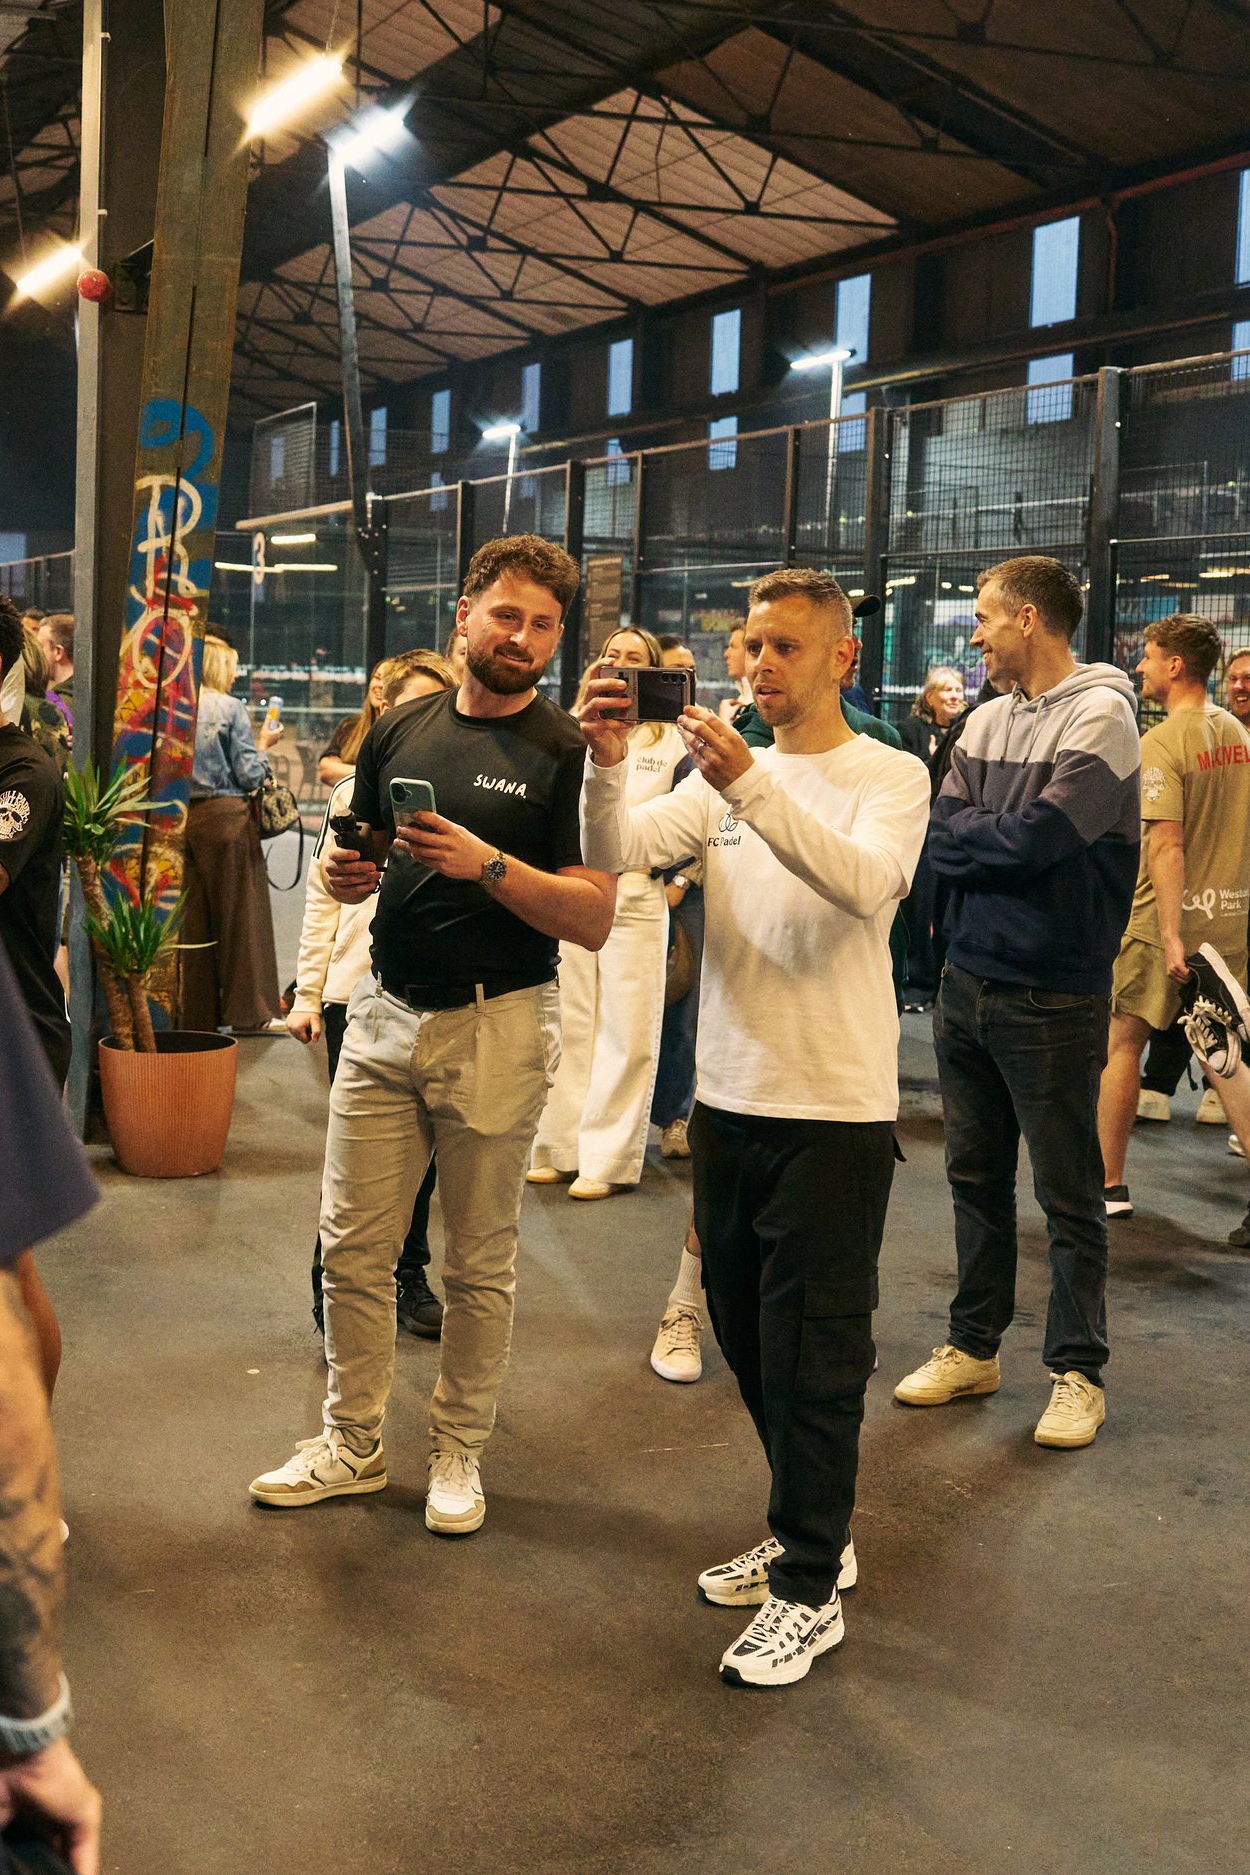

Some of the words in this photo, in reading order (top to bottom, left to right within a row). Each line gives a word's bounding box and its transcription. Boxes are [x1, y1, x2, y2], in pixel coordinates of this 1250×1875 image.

[637, 756, 655, 765] club
[636, 764, 660, 773] padel
[707, 837, 720, 847] FC
[720, 836, 742, 847] Padel
[1220, 899, 1242, 910] Park
